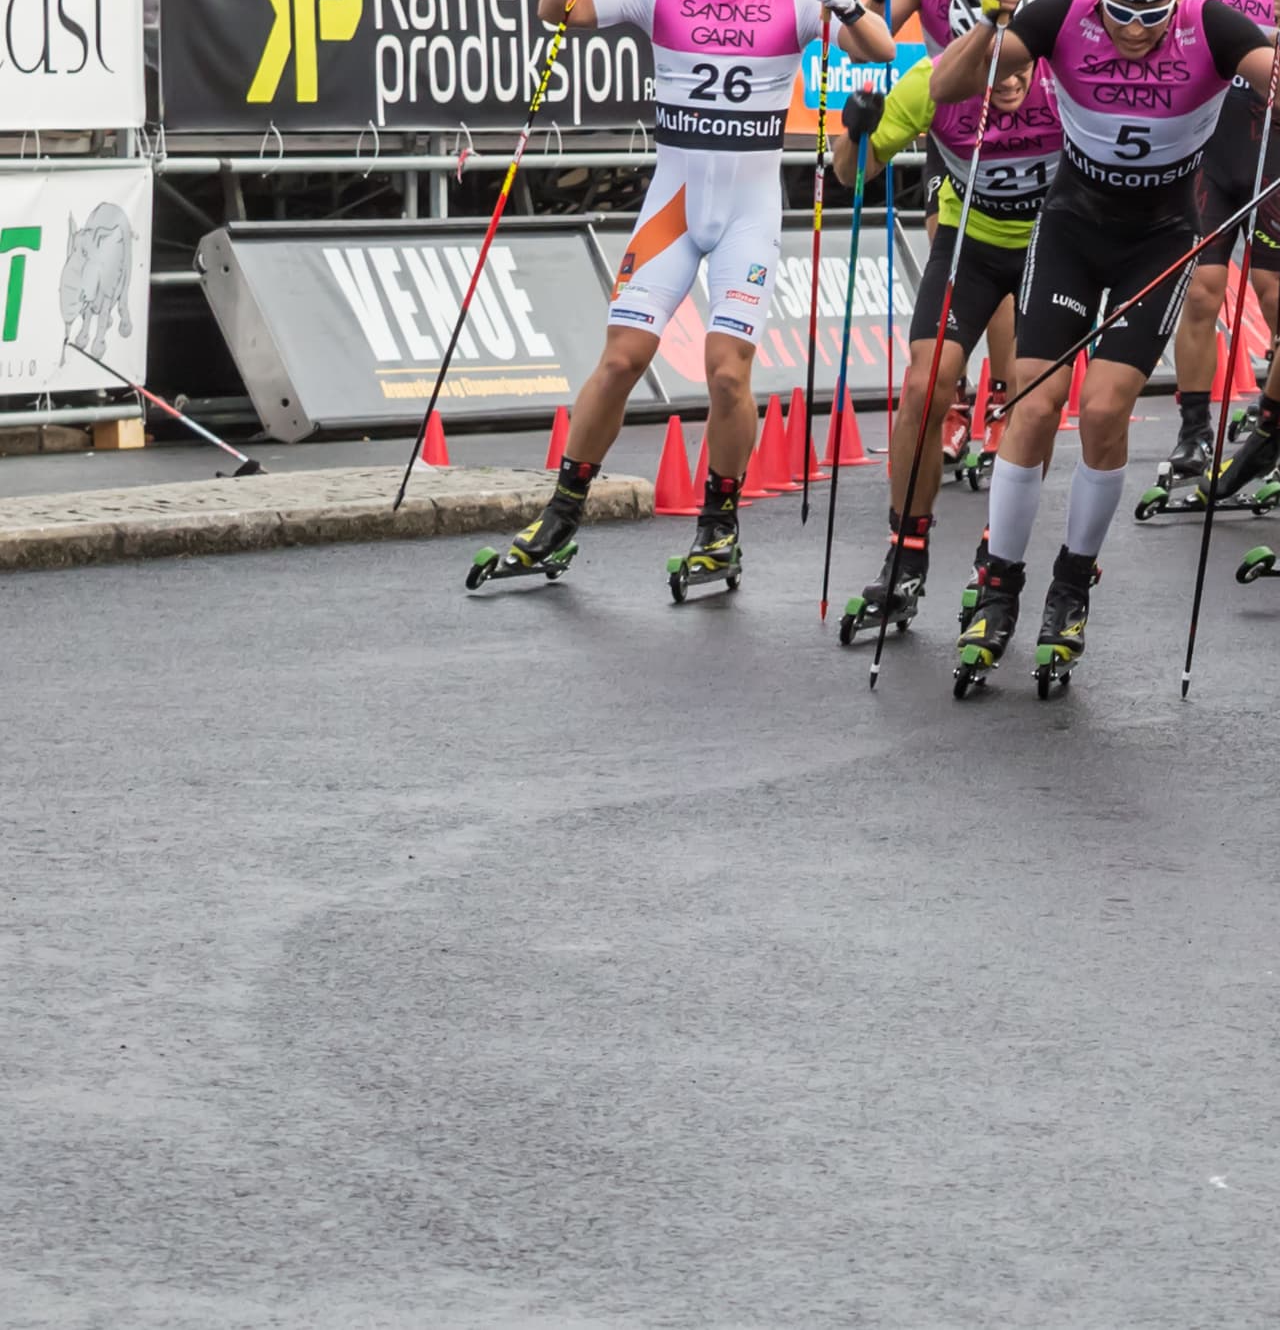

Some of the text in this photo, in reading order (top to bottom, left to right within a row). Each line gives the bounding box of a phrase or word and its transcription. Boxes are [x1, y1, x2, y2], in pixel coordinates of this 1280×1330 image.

[680, 0, 772, 22] SANDNES
[691, 27, 755, 48] GARN
[375, 36, 640, 125] produksjon
[688, 63, 752, 103] 26
[1078, 55, 1190, 82] SANDNES
[1093, 85, 1172, 109] GARN
[656, 106, 781, 138] Multiconsult
[1114, 125, 1151, 160] 5
[985, 161, 1047, 190] 21
[322, 246, 555, 361] VENUE
[1052, 293, 1087, 317] LUKOIL
